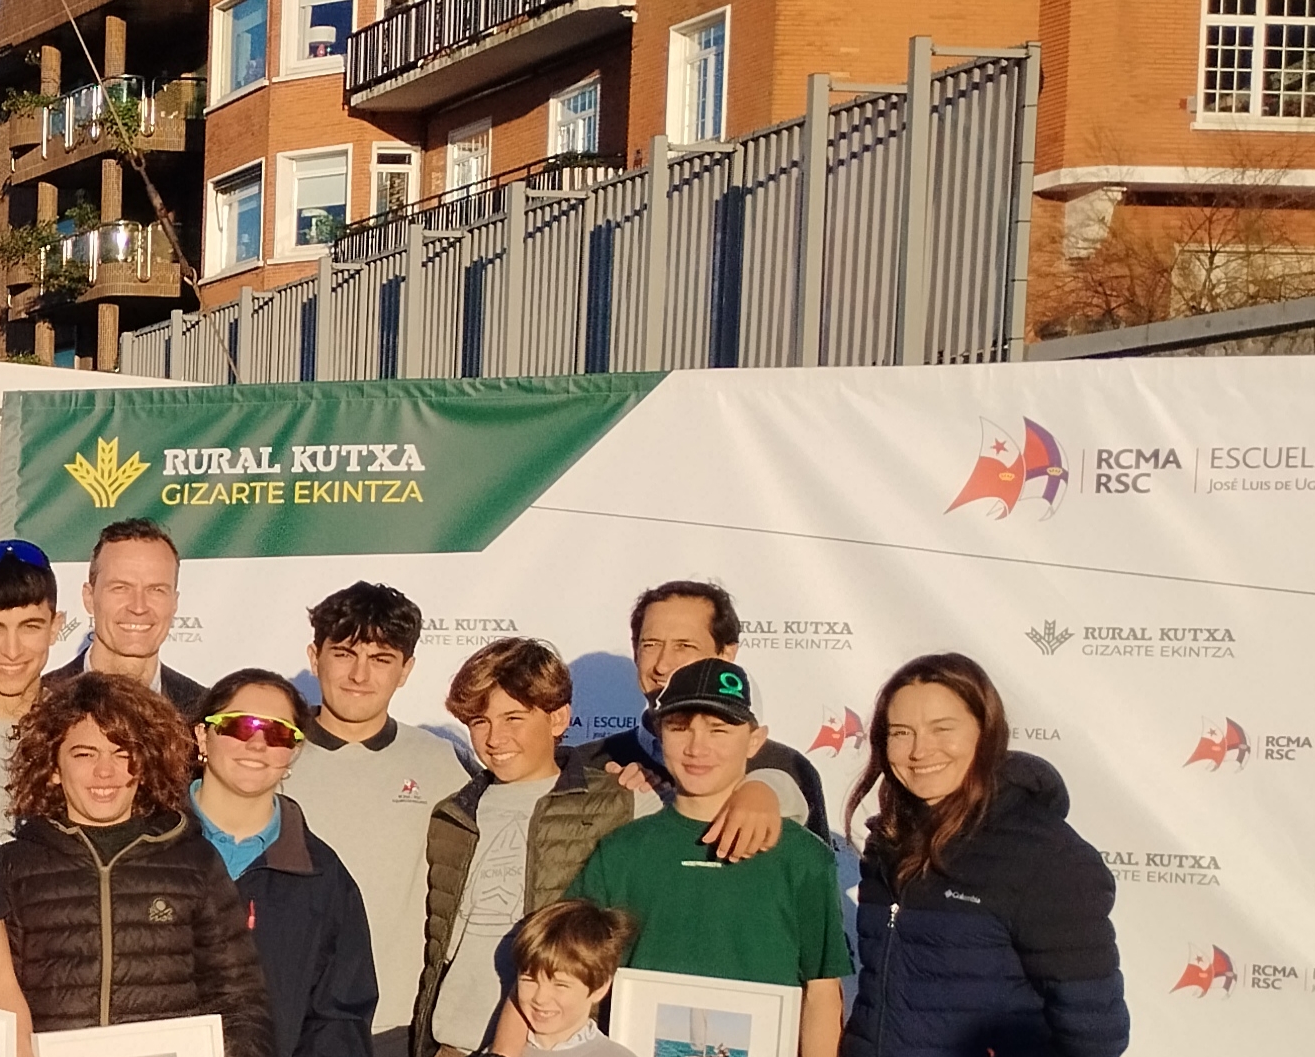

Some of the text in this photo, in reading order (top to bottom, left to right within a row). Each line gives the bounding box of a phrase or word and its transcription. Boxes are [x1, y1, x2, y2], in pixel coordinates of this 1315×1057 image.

[162, 444, 426, 475] RURAL KUTXA
[1096, 447, 1183, 470] RCMA
[1210, 446, 1315, 469] ESCUEL
[1095, 472, 1152, 494] RSC
[161, 480, 424, 505] GIZARTE EKINTZA
[454, 618, 519, 632] KUTXA
[739, 620, 854, 635] RAL KUTXA
[1083, 626, 1236, 642] RURAL KUTXA
[738, 637, 852, 650] ARTE EKINTZA
[1081, 644, 1235, 658] GIZARTE EKINTZA
[1024, 728, 1061, 741] VELA
[1265, 735, 1313, 748] RCMA
[1264, 748, 1296, 761] RSC
[1145, 852, 1221, 870] KUTXA
[1146, 870, 1221, 887] EKINTZA
[1251, 963, 1299, 979] RCMA
[1250, 976, 1283, 990] RSC
